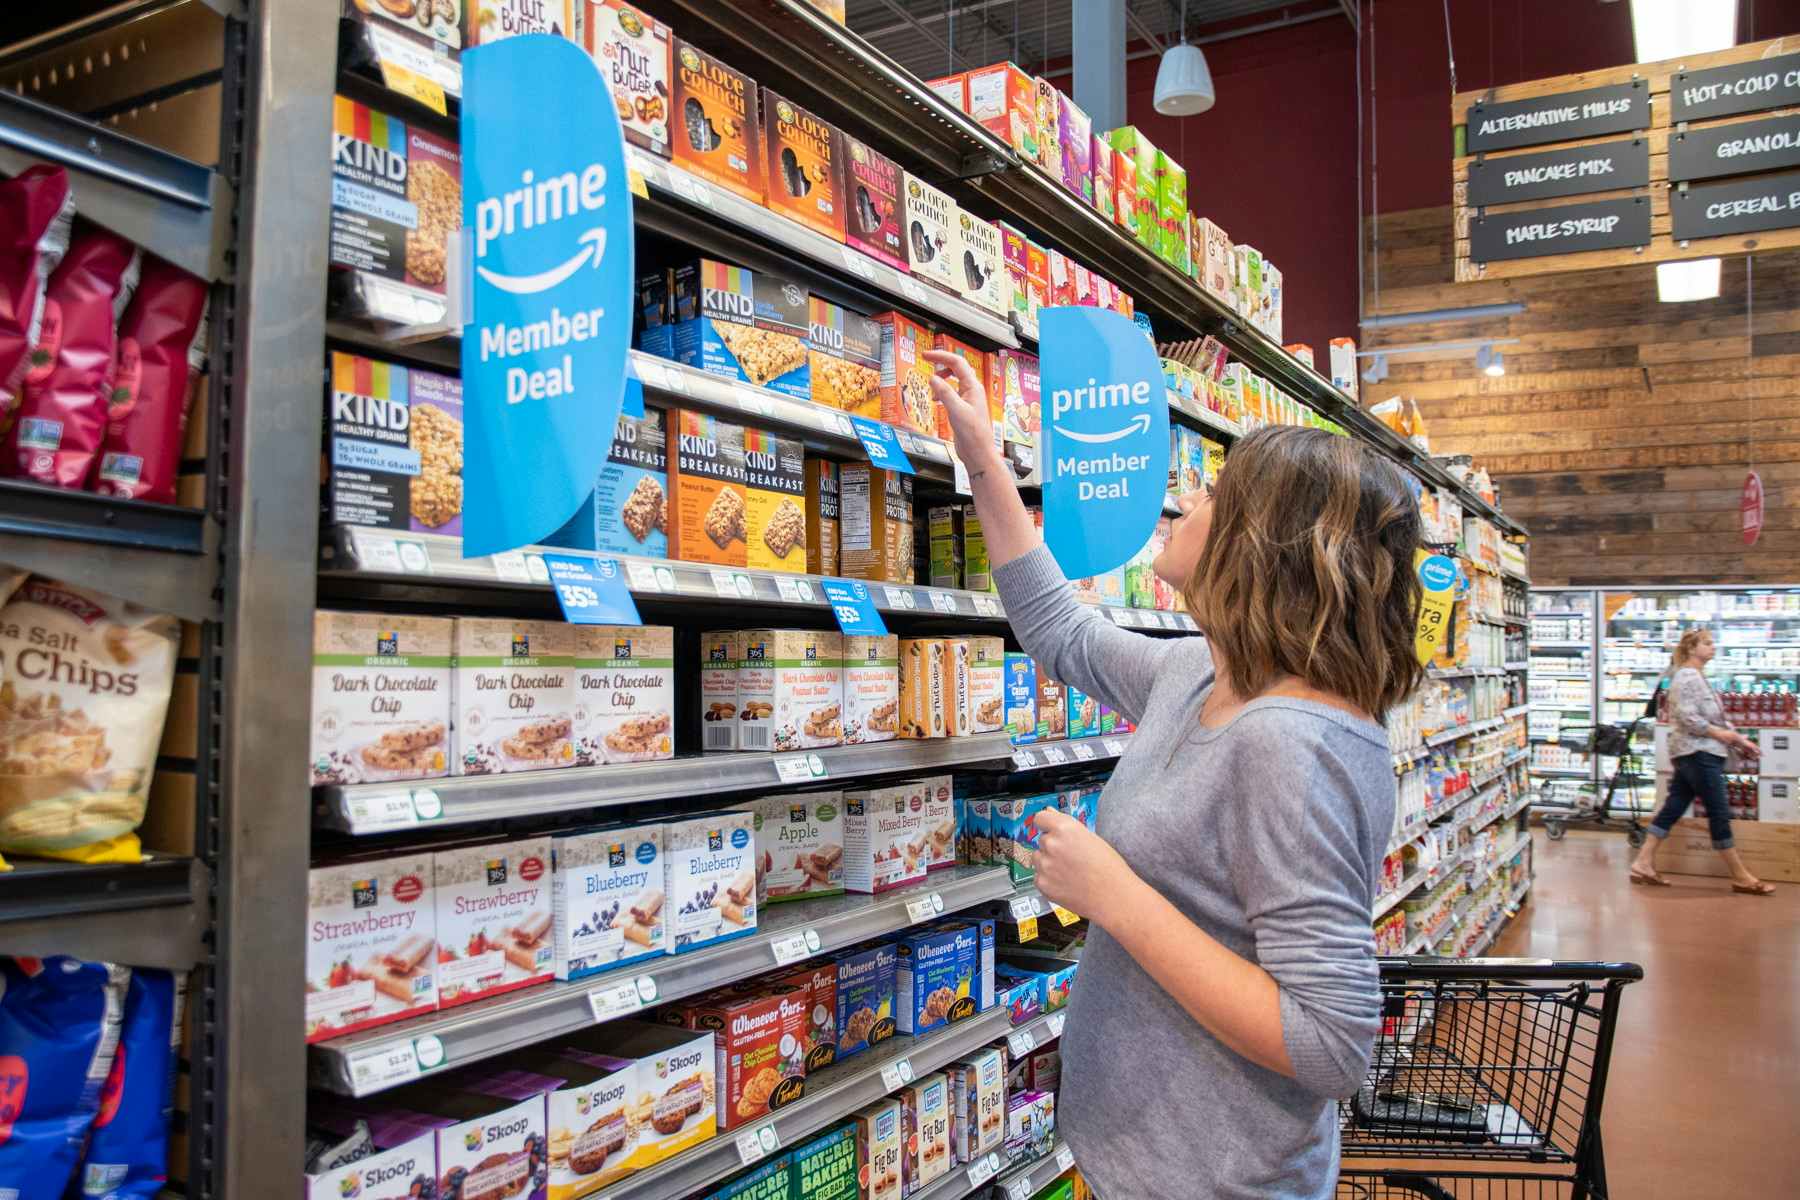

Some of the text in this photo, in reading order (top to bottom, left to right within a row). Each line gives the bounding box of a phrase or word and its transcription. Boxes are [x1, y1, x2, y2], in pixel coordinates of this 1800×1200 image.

[1683, 83, 1722, 107] HOT
[1734, 73, 1779, 96] COLD
[1479, 97, 1631, 135] ALTERNATIVE MILKS
[333, 132, 407, 182] KIND
[334, 165, 405, 195] HEALTHY GRAINS
[1505, 157, 1614, 187] PANCAKE MIX
[477, 163, 607, 258] prime
[1706, 195, 1787, 219] CEREAL
[1506, 215, 1620, 245] MAPLE SYRUP
[702, 288, 754, 316] KIND
[704, 310, 753, 326] HEALTHY GRAINS
[480, 306, 604, 361] Member
[809, 322, 843, 349] KIND
[507, 355, 575, 405] Deal
[334, 391, 410, 431] KIND
[1052, 378, 1151, 421] prime
[336, 423, 408, 443] HEALTHY GRAINS
[680, 434, 717, 458] KIND
[680, 459, 745, 482] BREAKFAST
[1057, 453, 1150, 476] Member
[885, 480, 901, 495] KIND
[1079, 478, 1129, 501] Deal
[28, 625, 79, 652] Salt
[15, 647, 139, 697] Chips
[332, 673, 438, 692] Dark Chocolate
[475, 672, 565, 690] Dark Chocolate
[580, 674, 664, 690] Dark Chocolate
[371, 695, 403, 718] Chip
[508, 692, 536, 713] Chip
[611, 692, 636, 710] Chip
[928, 805, 948, 817] Berry
[778, 823, 819, 843] Apple
[878, 816, 922, 833] Mixed Berry
[690, 854, 742, 876] Blueberry
[585, 871, 649, 895] Blueberry
[455, 887, 538, 915] Strawberry
[312, 910, 417, 942] Strawberry
[917, 935, 972, 961] Whenever Bars
[839, 958, 876, 980] Whenever
[732, 998, 801, 1036] Whenever Bars
[669, 1052, 702, 1072] Skoop
[592, 1083, 626, 1108] Skoop
[982, 1092, 1000, 1114] Fig Bar
[486, 1117, 529, 1144] Skoop
[922, 1118, 945, 1143] Fig Bar
[365, 1157, 416, 1189] Skoop
[802, 1152, 855, 1194] BAKERY
[874, 1147, 899, 1174] Fig Bar
[831, 1179, 844, 1194] BAR
